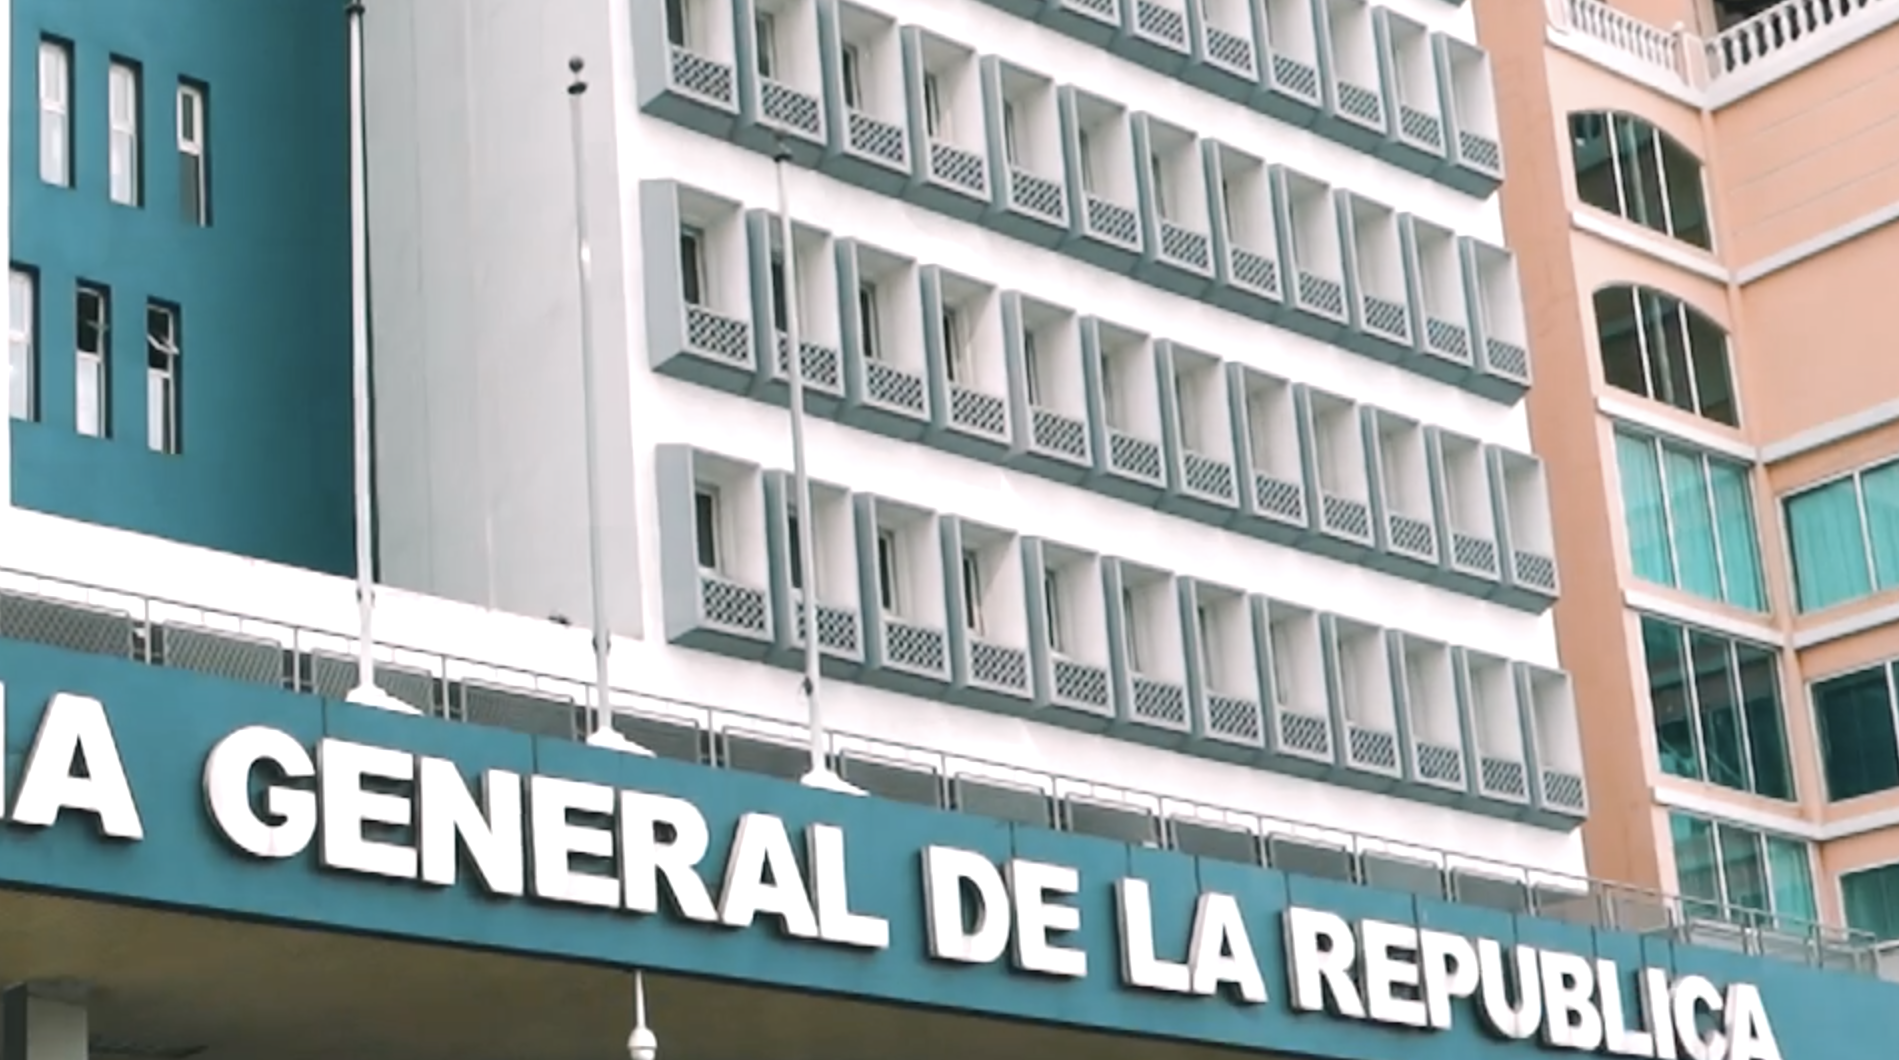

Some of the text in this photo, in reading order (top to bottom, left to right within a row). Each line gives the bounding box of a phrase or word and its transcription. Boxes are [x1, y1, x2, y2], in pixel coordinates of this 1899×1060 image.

[203, 725, 890, 949] GENERAL
[921, 844, 1088, 978] DE
[1114, 877, 1268, 1004] LA
